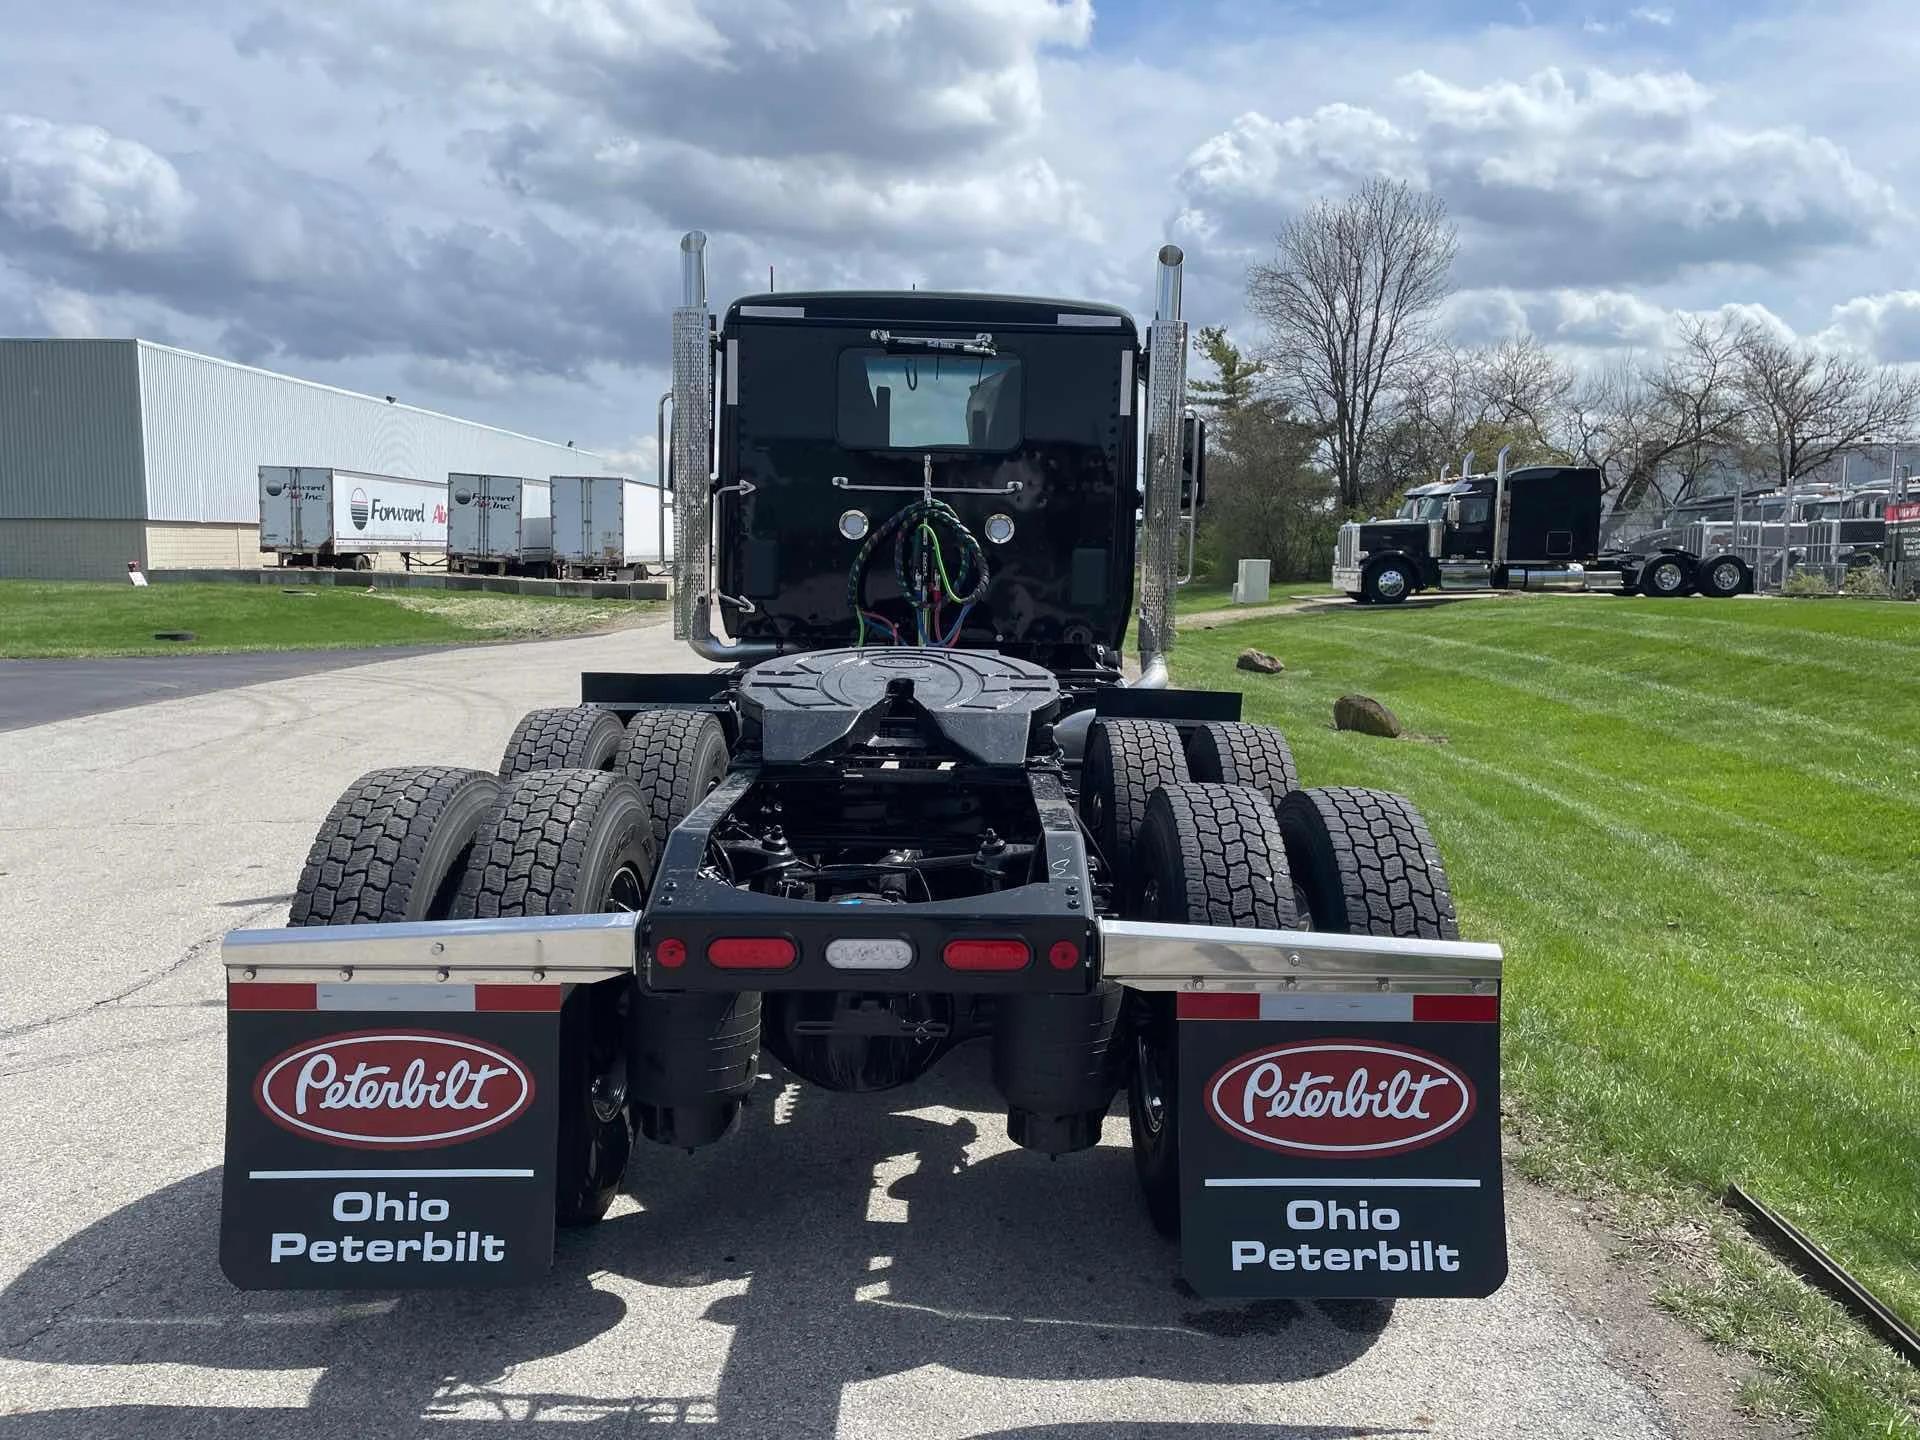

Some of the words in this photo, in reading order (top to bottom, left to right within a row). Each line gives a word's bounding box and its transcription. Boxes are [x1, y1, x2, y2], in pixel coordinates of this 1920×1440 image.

[370, 498, 425, 522] Forward
[295, 1053, 509, 1115] Peterbilt
[1243, 1062, 1449, 1123] Peterbilt
[332, 1191, 450, 1222] Ohio
[1286, 1200, 1400, 1231] Ohio
[270, 1231, 505, 1263] Peterbilt
[1231, 1240, 1460, 1272] Peterbilt
